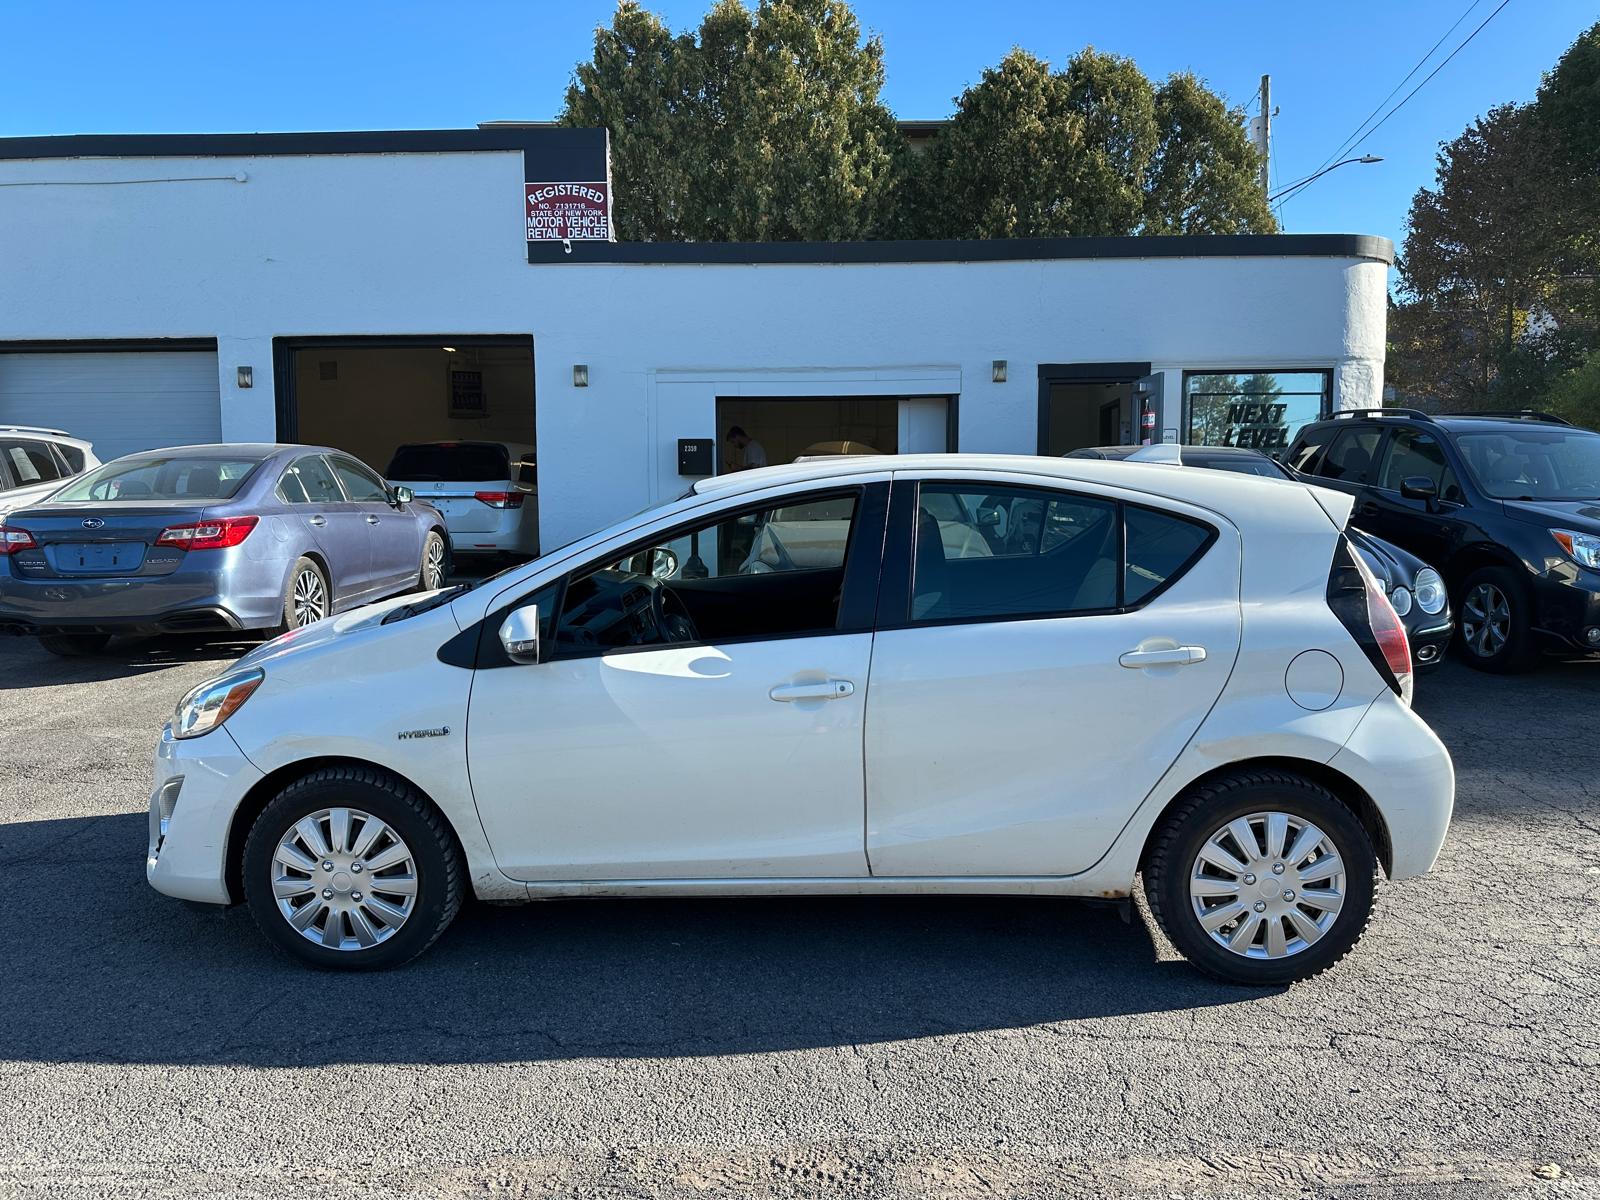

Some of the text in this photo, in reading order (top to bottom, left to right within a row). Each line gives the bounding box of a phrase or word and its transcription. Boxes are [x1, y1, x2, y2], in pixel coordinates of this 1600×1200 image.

[527, 184, 604, 205] REGISTERED
[527, 216, 608, 228] MOTOR VEHICLE
[528, 228, 608, 239] RETAIL DEALER
[1226, 404, 1288, 424] NEXT
[1223, 428, 1289, 447] LEVEL
